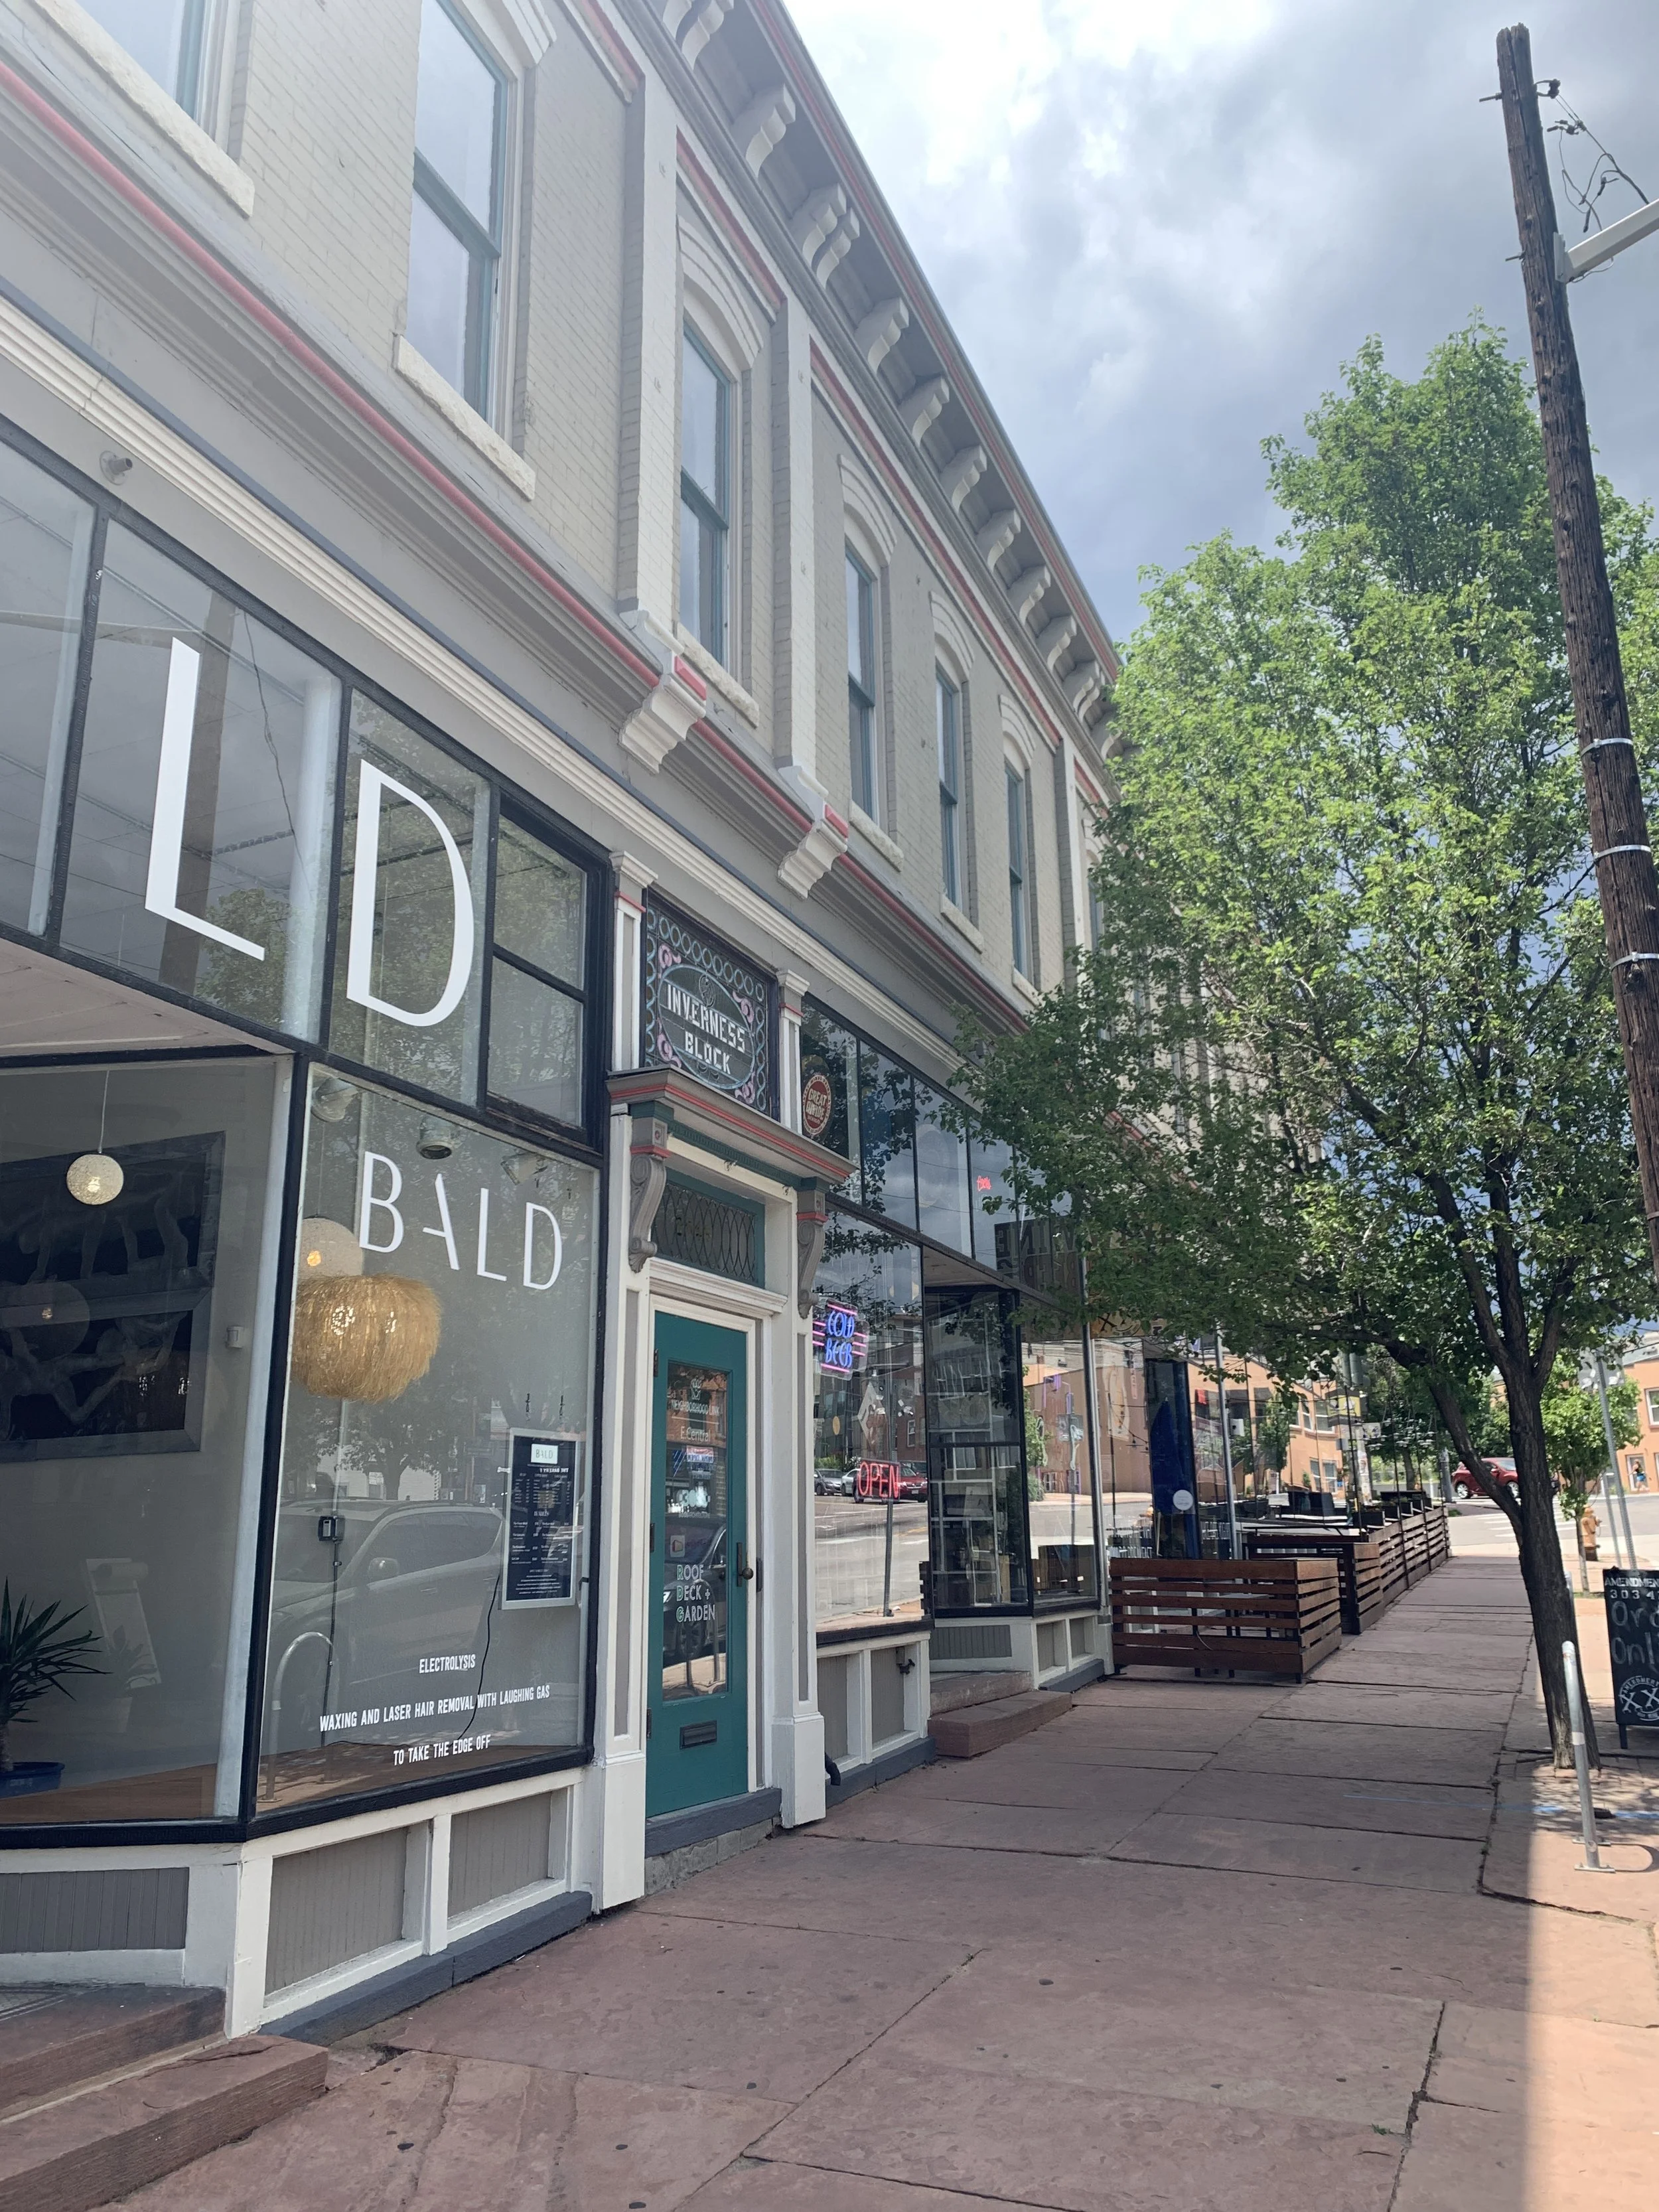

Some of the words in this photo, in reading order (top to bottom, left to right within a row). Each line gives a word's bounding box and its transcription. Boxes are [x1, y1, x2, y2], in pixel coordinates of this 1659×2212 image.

[668, 984, 745, 1053] INVERNESS
[685, 1031, 731, 1075] BLOCK
[808, 1088, 828, 1106] GREAT
[359, 1151, 563, 1291] BALD
[828, 1309, 855, 1339] COLD
[825, 1338, 853, 1368] BEER
[536, 1449, 553, 1459] BALD
[857, 1461, 899, 1499] OPEN
[677, 1564, 703, 1580] ROOF
[676, 1585, 702, 1601] DECK
[676, 1604, 715, 1623] GARDEN
[419, 1654, 476, 1673] ELECTROLYSIS
[320, 1711, 357, 1732] WAXING
[360, 1708, 380, 1726] AND
[384, 1704, 411, 1723] LASER
[414, 1701, 434, 1718] HAIR
[437, 1695, 474, 1714] REMOVAL
[477, 1692, 497, 1708] WITH
[500, 1686, 534, 1705] LAUGHING
[536, 1684, 550, 1700] GAS
[394, 1749, 404, 1766] TO
[407, 1745, 429, 1763] TAKE
[433, 1741, 450, 1758] THE
[453, 1738, 473, 1755] EDGE
[476, 1734, 491, 1751] OFF
